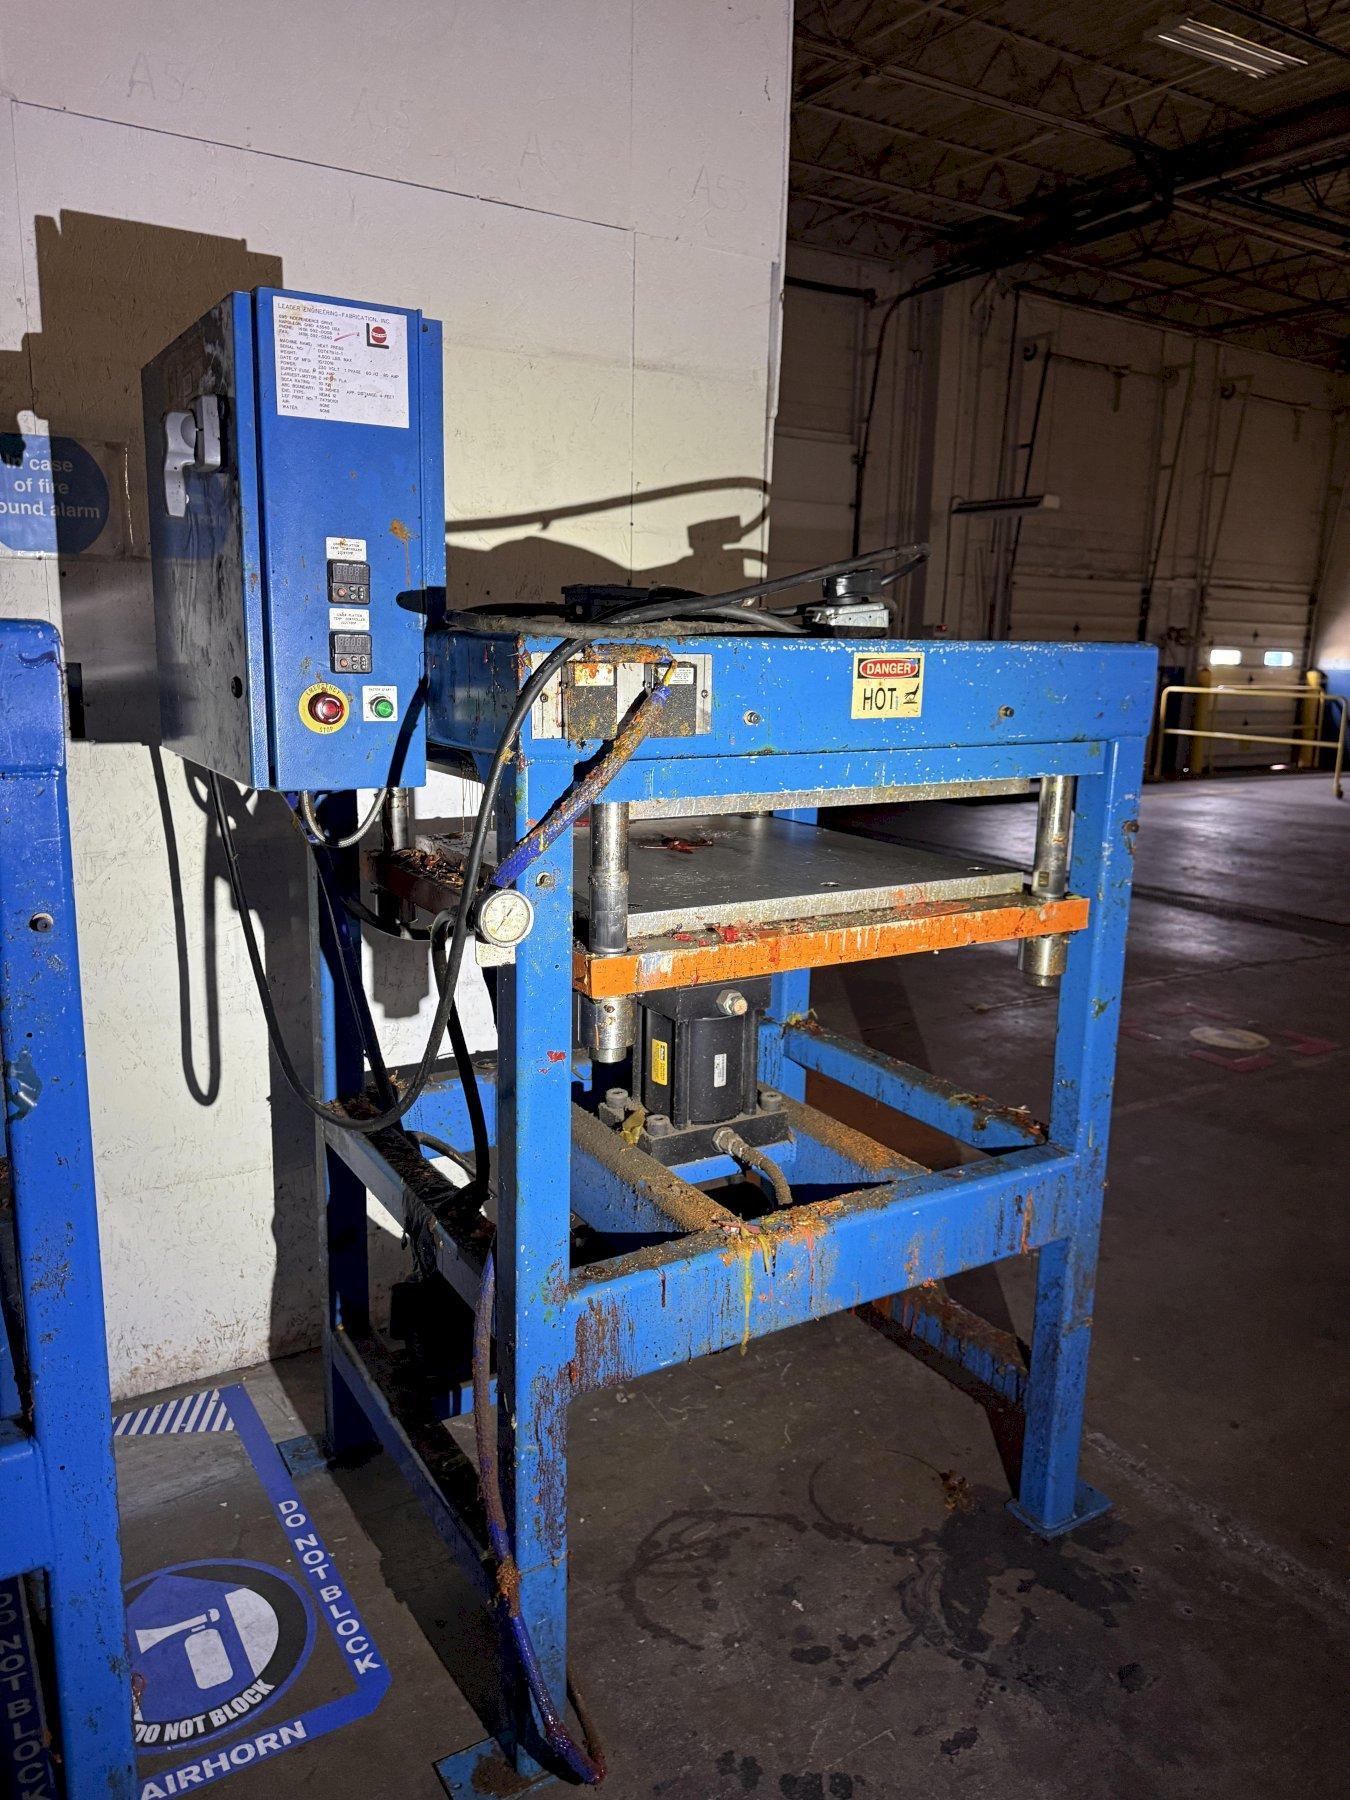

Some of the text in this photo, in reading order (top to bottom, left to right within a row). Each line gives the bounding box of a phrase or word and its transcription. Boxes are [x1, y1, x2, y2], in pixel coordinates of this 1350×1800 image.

[277, 303, 300, 311] LEADER
[29, 458, 74, 473] case
[14, 478, 70, 495] of fire
[50, 501, 101, 519] alarm
[866, 662, 912, 675] DANGER
[862, 687, 897, 711] HOT
[278, 1500, 381, 1675] DO NOT BLOCK
[163, 1714, 206, 1742] NOT
[208, 1679, 276, 1728] BLOCK
[140, 1720, 307, 1800] AIRHORN
